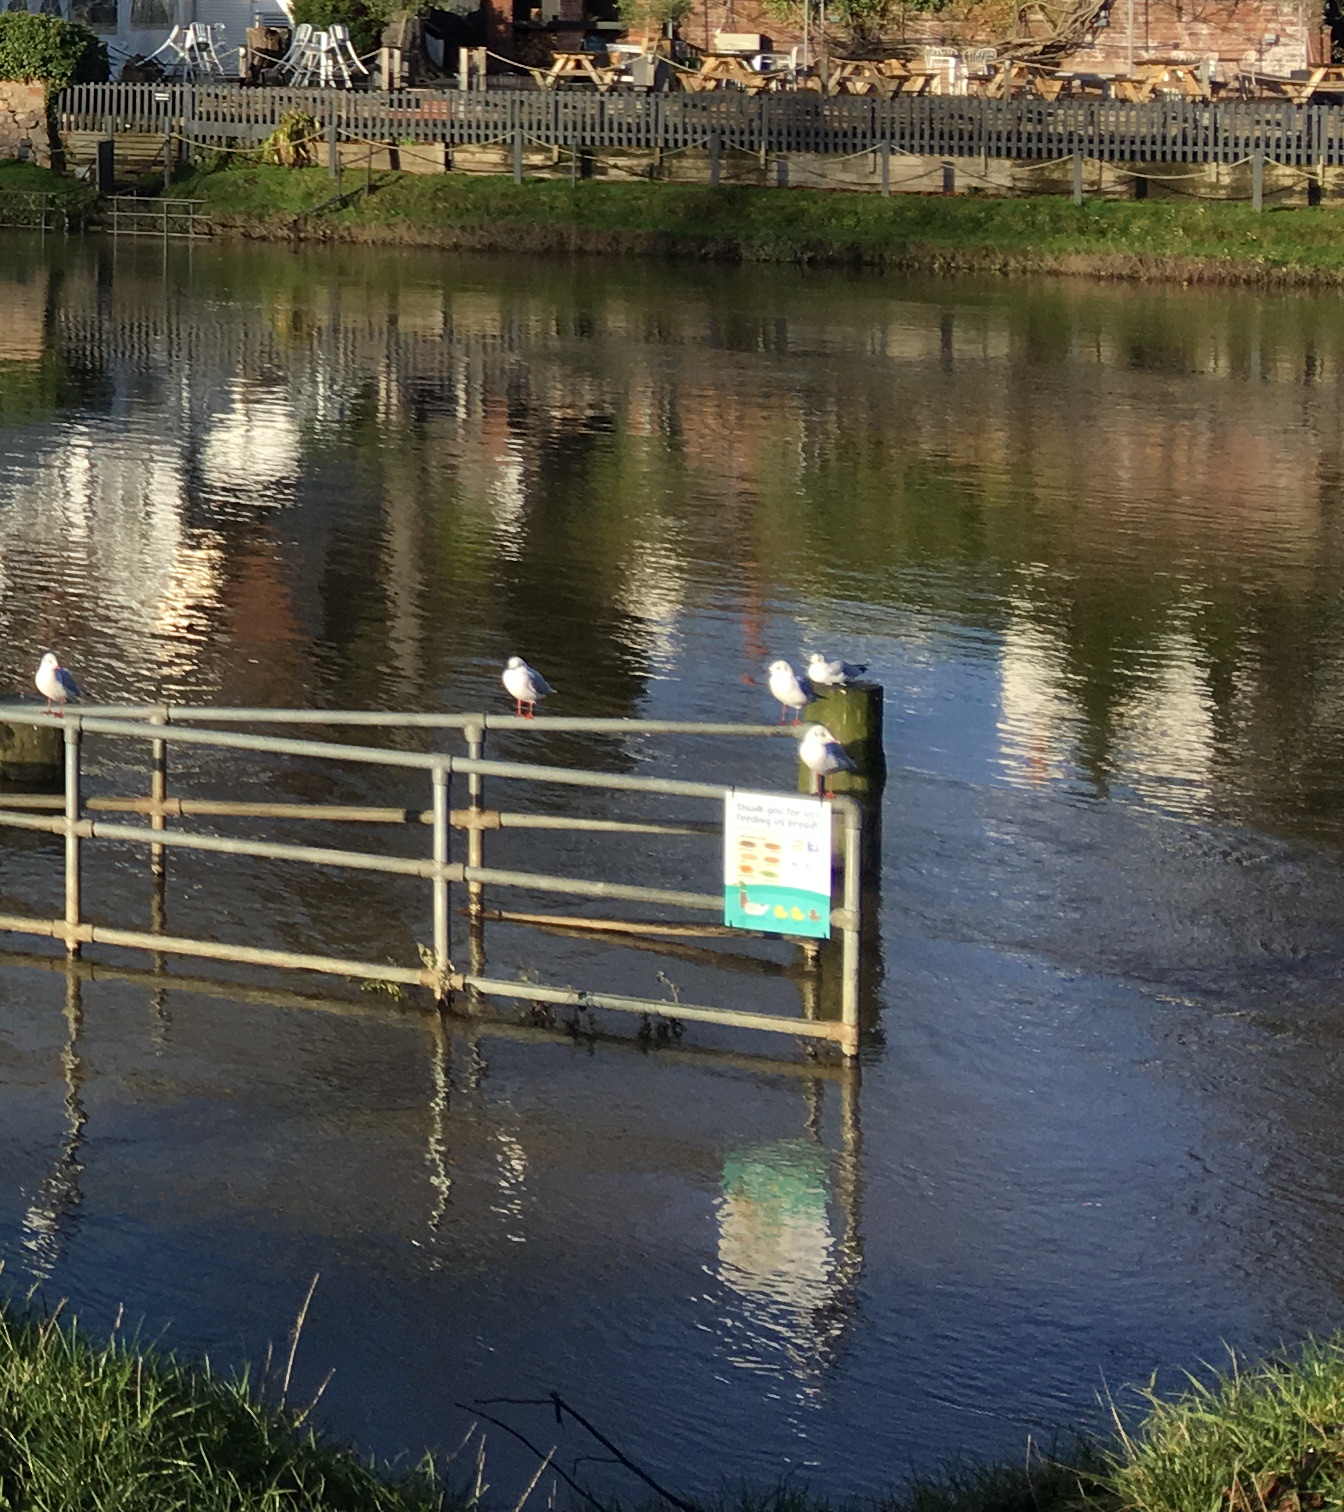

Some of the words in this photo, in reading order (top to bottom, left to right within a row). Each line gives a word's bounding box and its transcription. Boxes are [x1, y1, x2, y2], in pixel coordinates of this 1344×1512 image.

[767, 808, 784, 817] you
[787, 808, 800, 816] for
[736, 813, 771, 827] feeding
